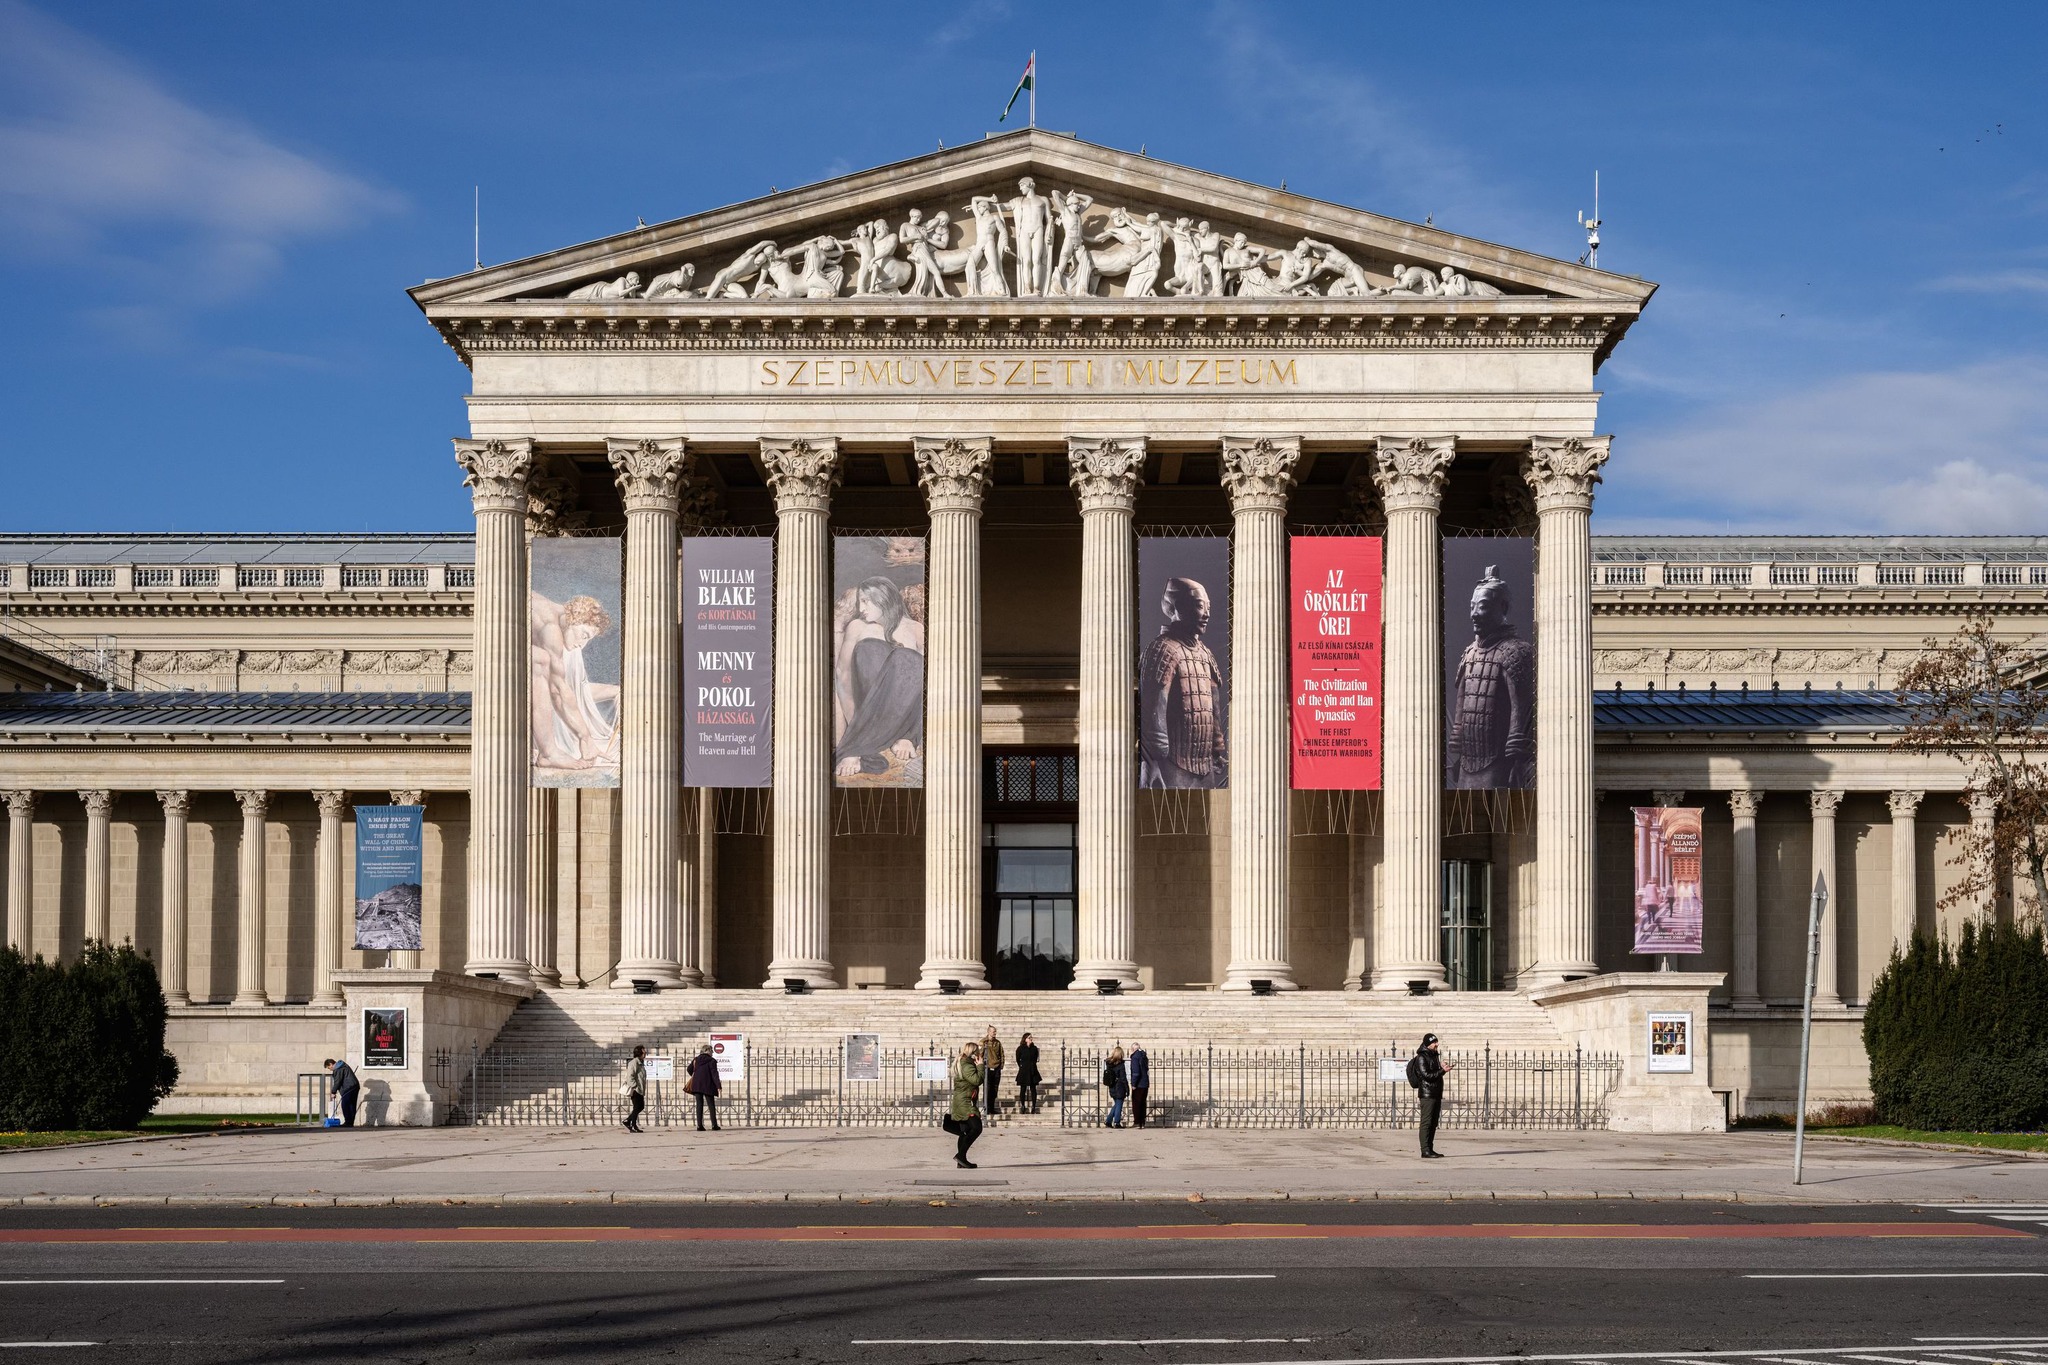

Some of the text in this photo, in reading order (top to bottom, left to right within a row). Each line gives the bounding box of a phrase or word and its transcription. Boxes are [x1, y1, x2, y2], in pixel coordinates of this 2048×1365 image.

[761, 355, 1298, 386] SZÉPMŰVÉSZETI MÚZEUM
[699, 569, 755, 583] WILLIAM
[1326, 569, 1343, 588] AZ
[698, 587, 756, 605] BLAKE
[1304, 589, 1368, 611] ÖRÖKLÉT
[697, 608, 756, 620] és KORTÁRSAI
[1319, 612, 1351, 636] ŐREI
[1308, 641, 1324, 649] ELSŐ
[1326, 641, 1343, 649] KÍNAI
[1345, 641, 1374, 649] CSÁSZÁR
[698, 652, 756, 670] MENNY
[1312, 652, 1360, 660] AGYAGKATONÁI
[722, 673, 732, 683] és
[1304, 679, 1367, 691] The Civilization
[698, 687, 756, 706] POKOL
[1297, 693, 1373, 707] of the Qin and Han
[697, 709, 755, 724] HÁZASSÁGA
[1315, 709, 1356, 723] Dynasties
[699, 733, 756, 744] The Marriage of
[699, 745, 756, 755] Heaven and Hell
[1298, 749, 1337, 757] TERRACOTTA
